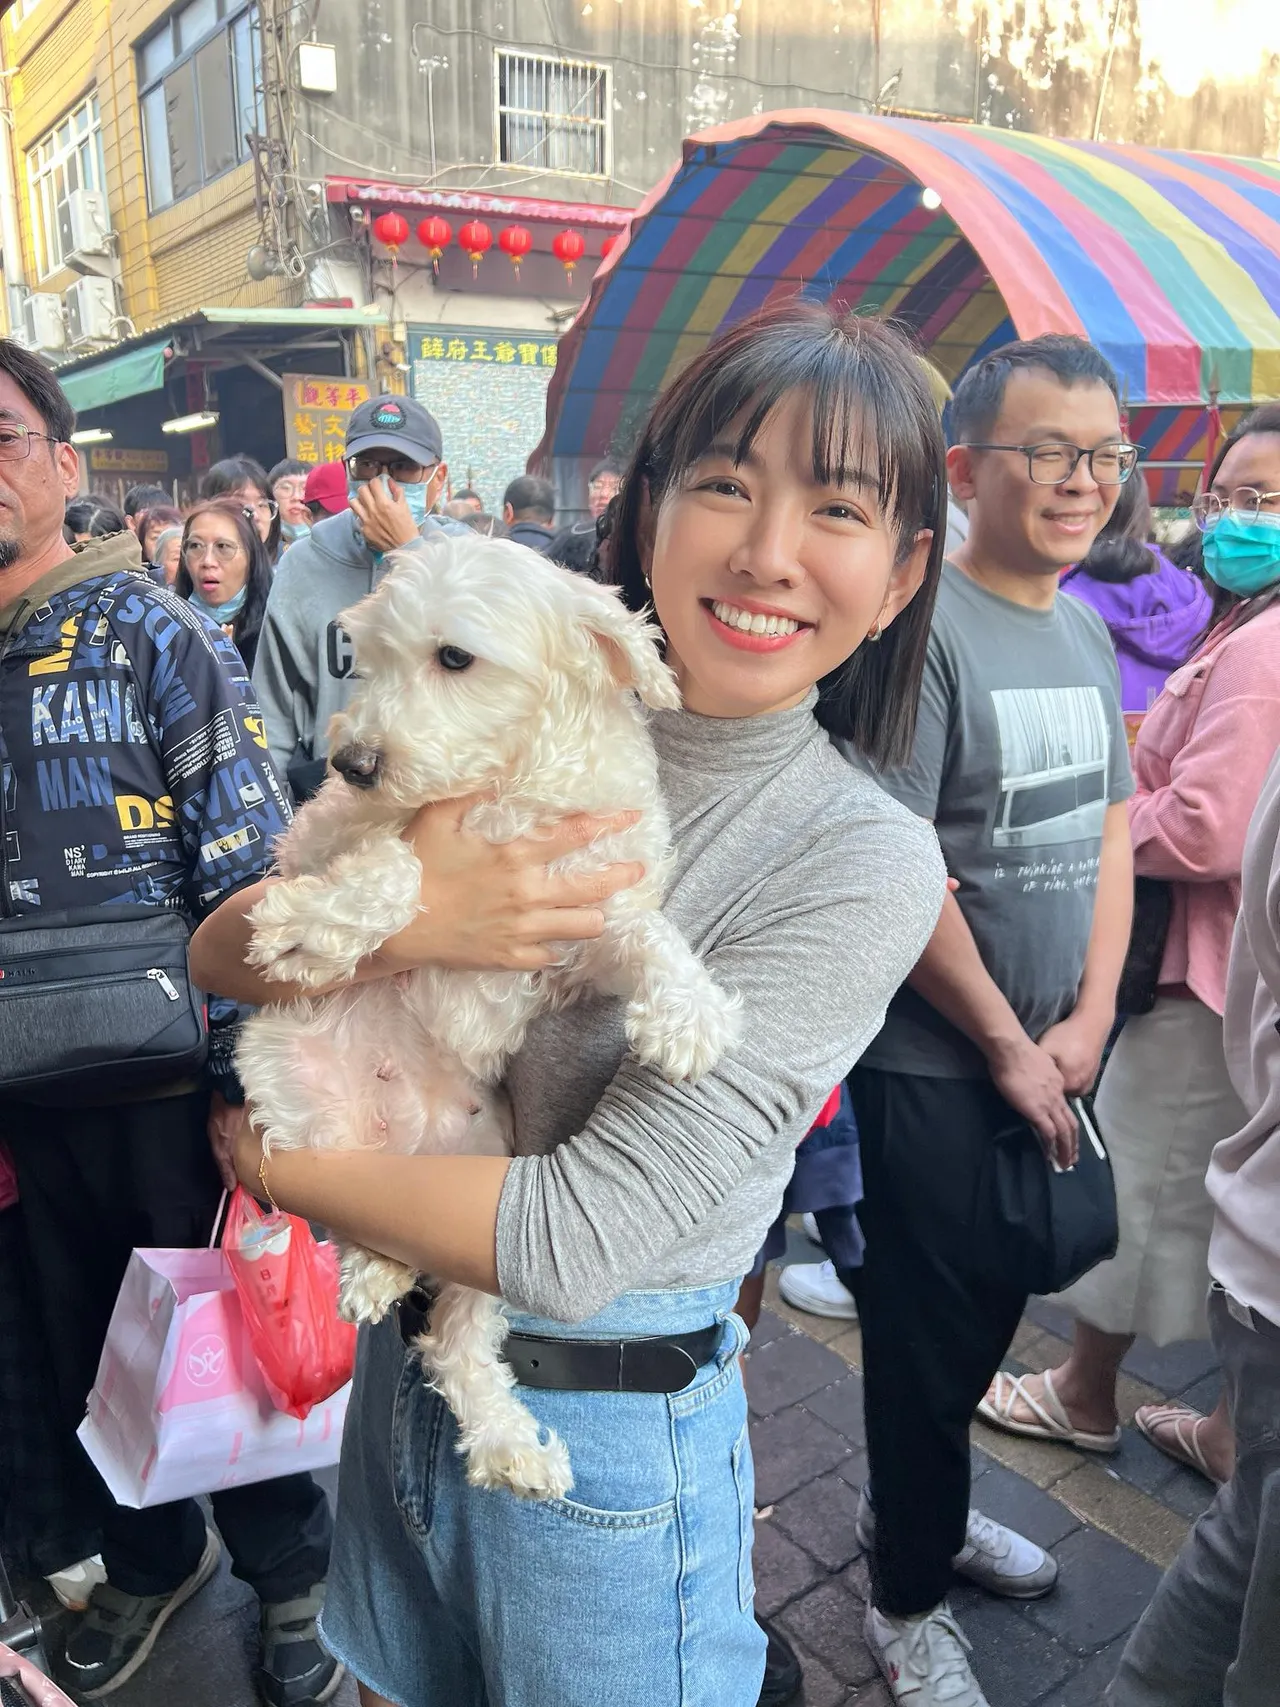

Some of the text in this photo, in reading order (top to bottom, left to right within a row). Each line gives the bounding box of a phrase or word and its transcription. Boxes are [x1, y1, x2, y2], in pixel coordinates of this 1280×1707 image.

[326, 620, 362, 680] C
[36, 757, 115, 811] MAN
[115, 795, 175, 831] DS
[65, 858, 87, 867] DIARY
